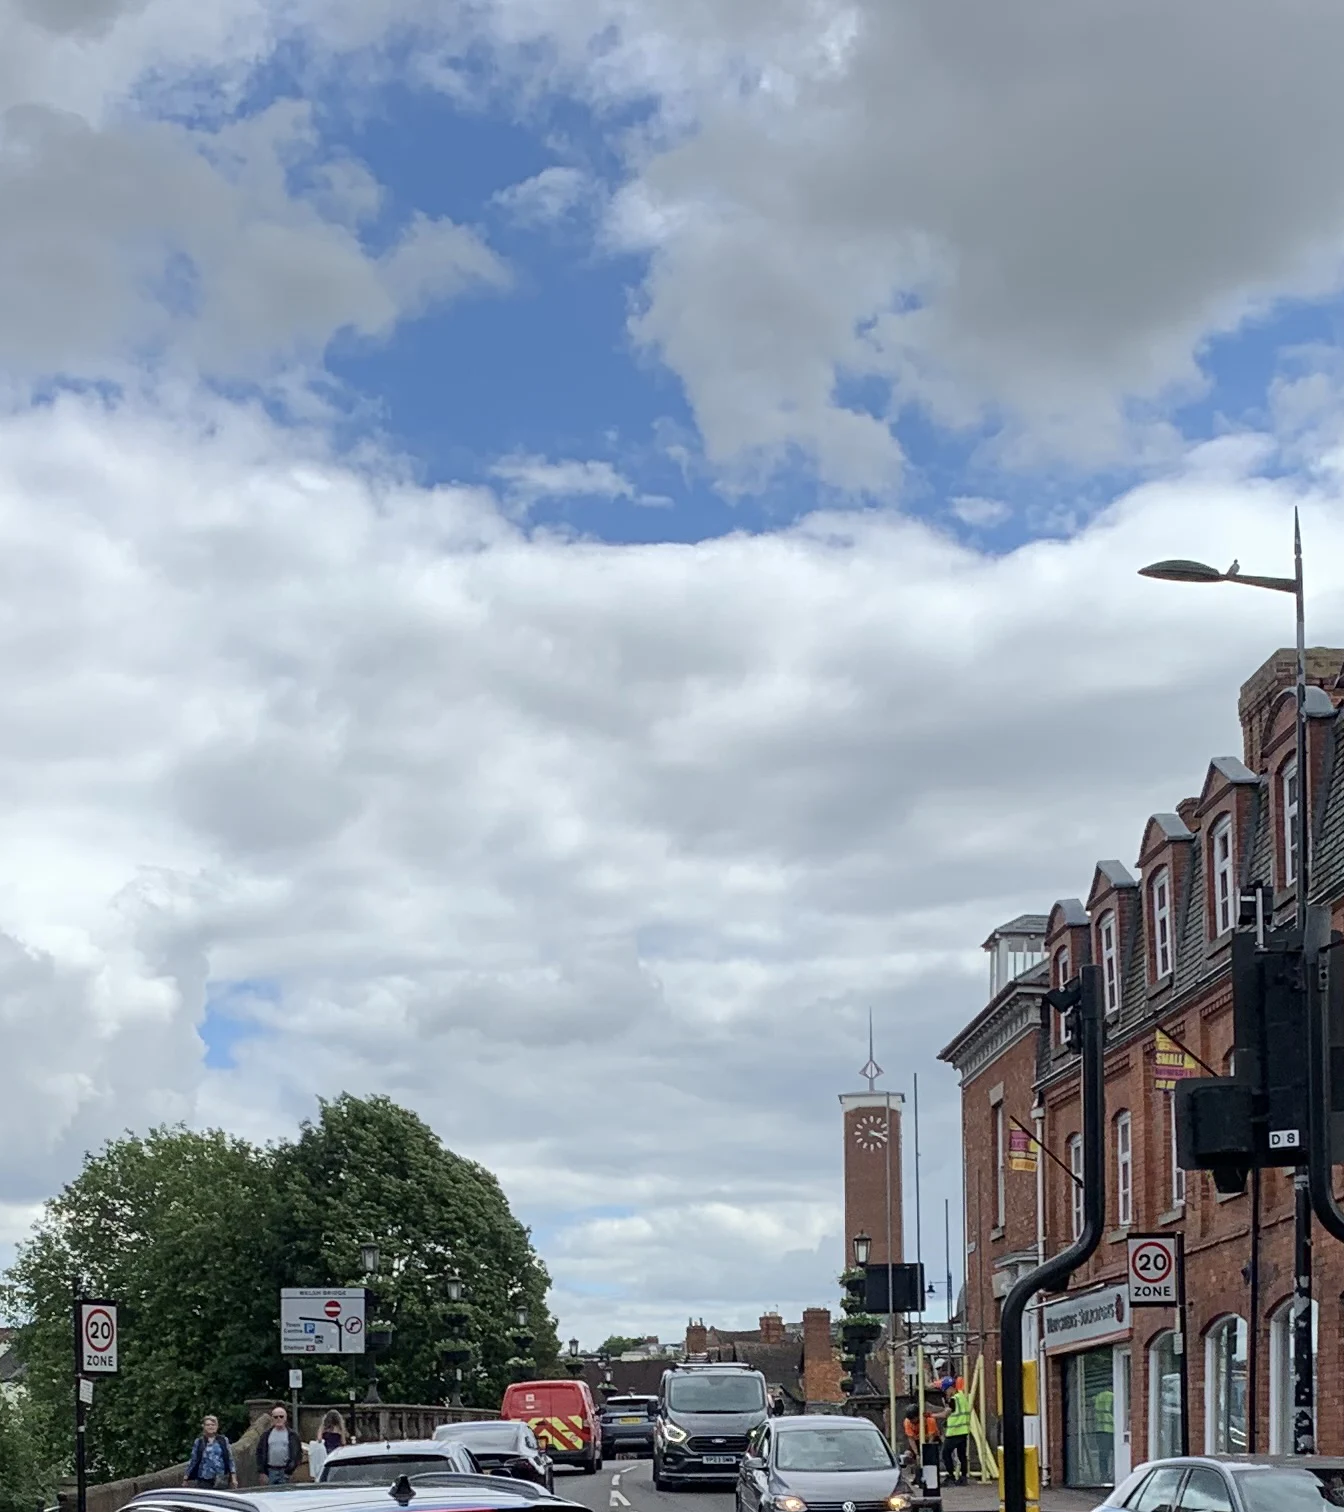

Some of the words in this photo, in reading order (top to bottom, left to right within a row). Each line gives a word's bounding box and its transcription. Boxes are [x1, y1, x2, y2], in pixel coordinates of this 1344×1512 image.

[1272, 1134, 1281, 1145] D
[1287, 1133, 1295, 1144] 8
[1139, 1253, 1167, 1271] 20
[1134, 1286, 1171, 1297] ZONE
[89, 1321, 111, 1339] 20
[87, 1355, 114, 1367] ZONE
